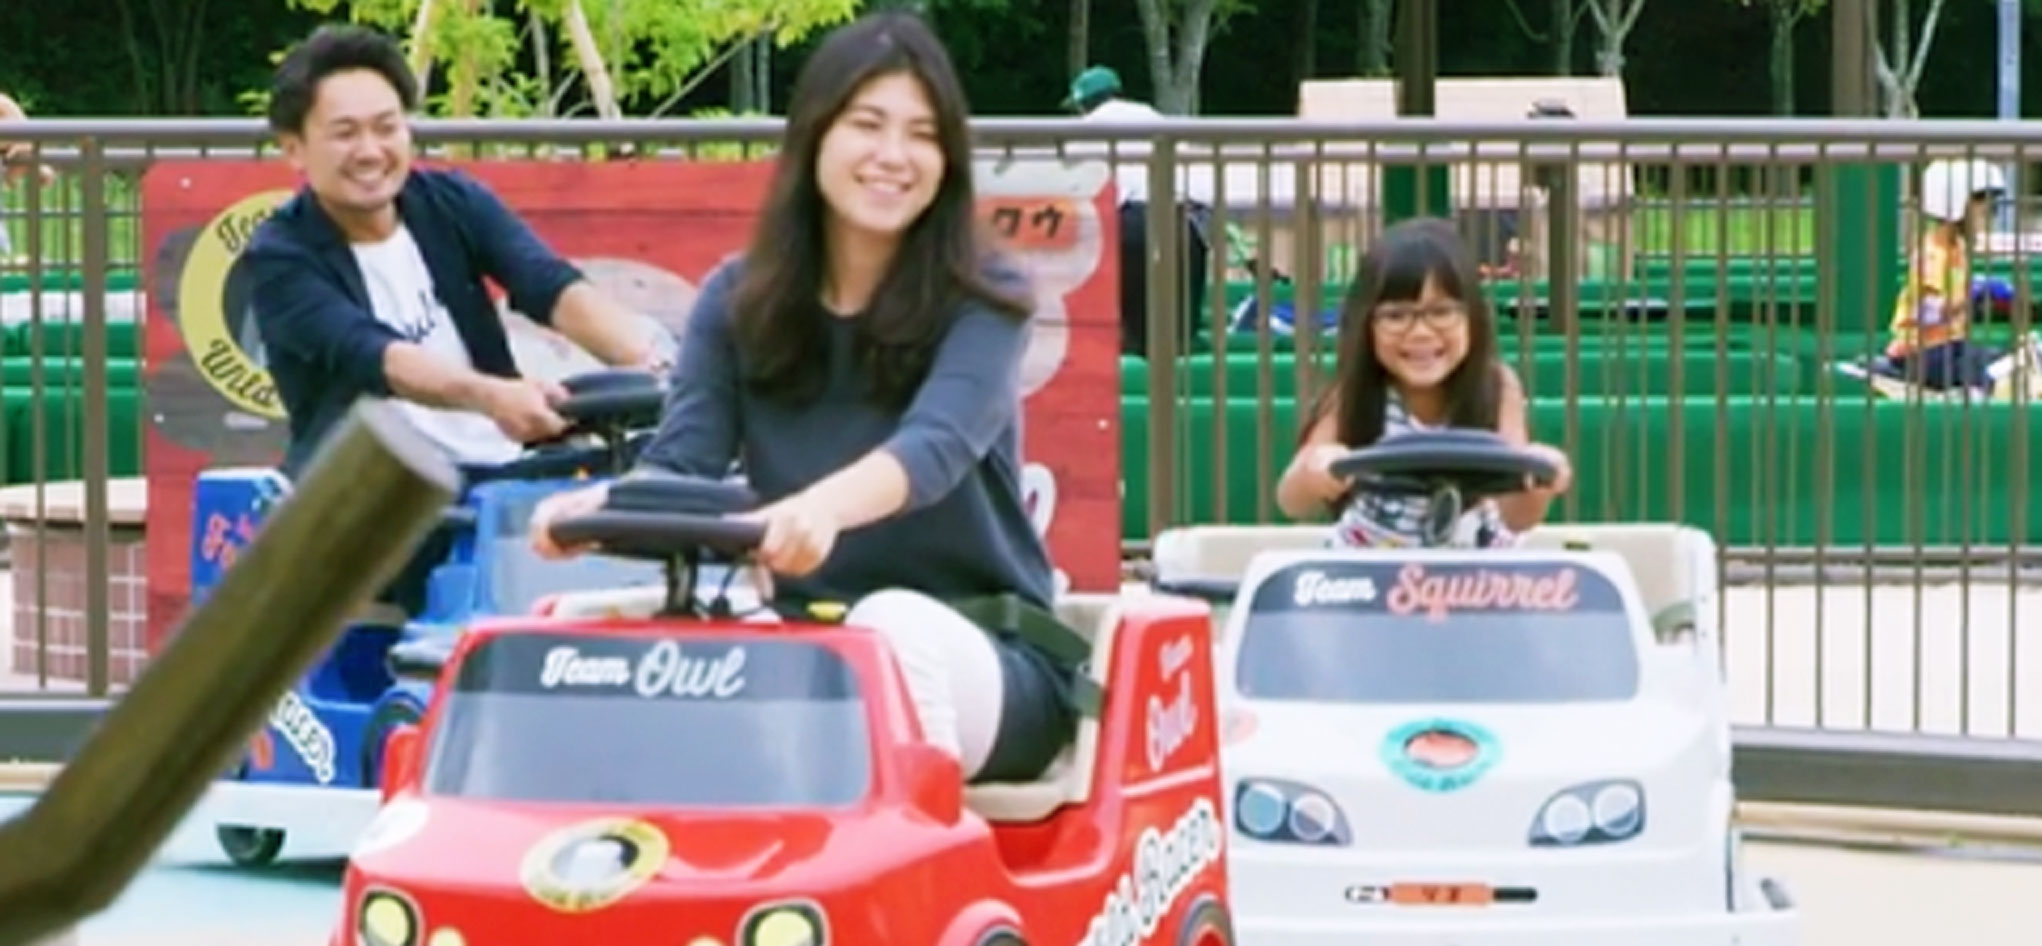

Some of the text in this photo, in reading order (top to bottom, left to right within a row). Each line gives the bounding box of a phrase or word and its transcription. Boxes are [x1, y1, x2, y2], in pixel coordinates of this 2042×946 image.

[1294, 561, 1580, 623] Team Squirrel
[540, 638, 747, 697] Team Owl
